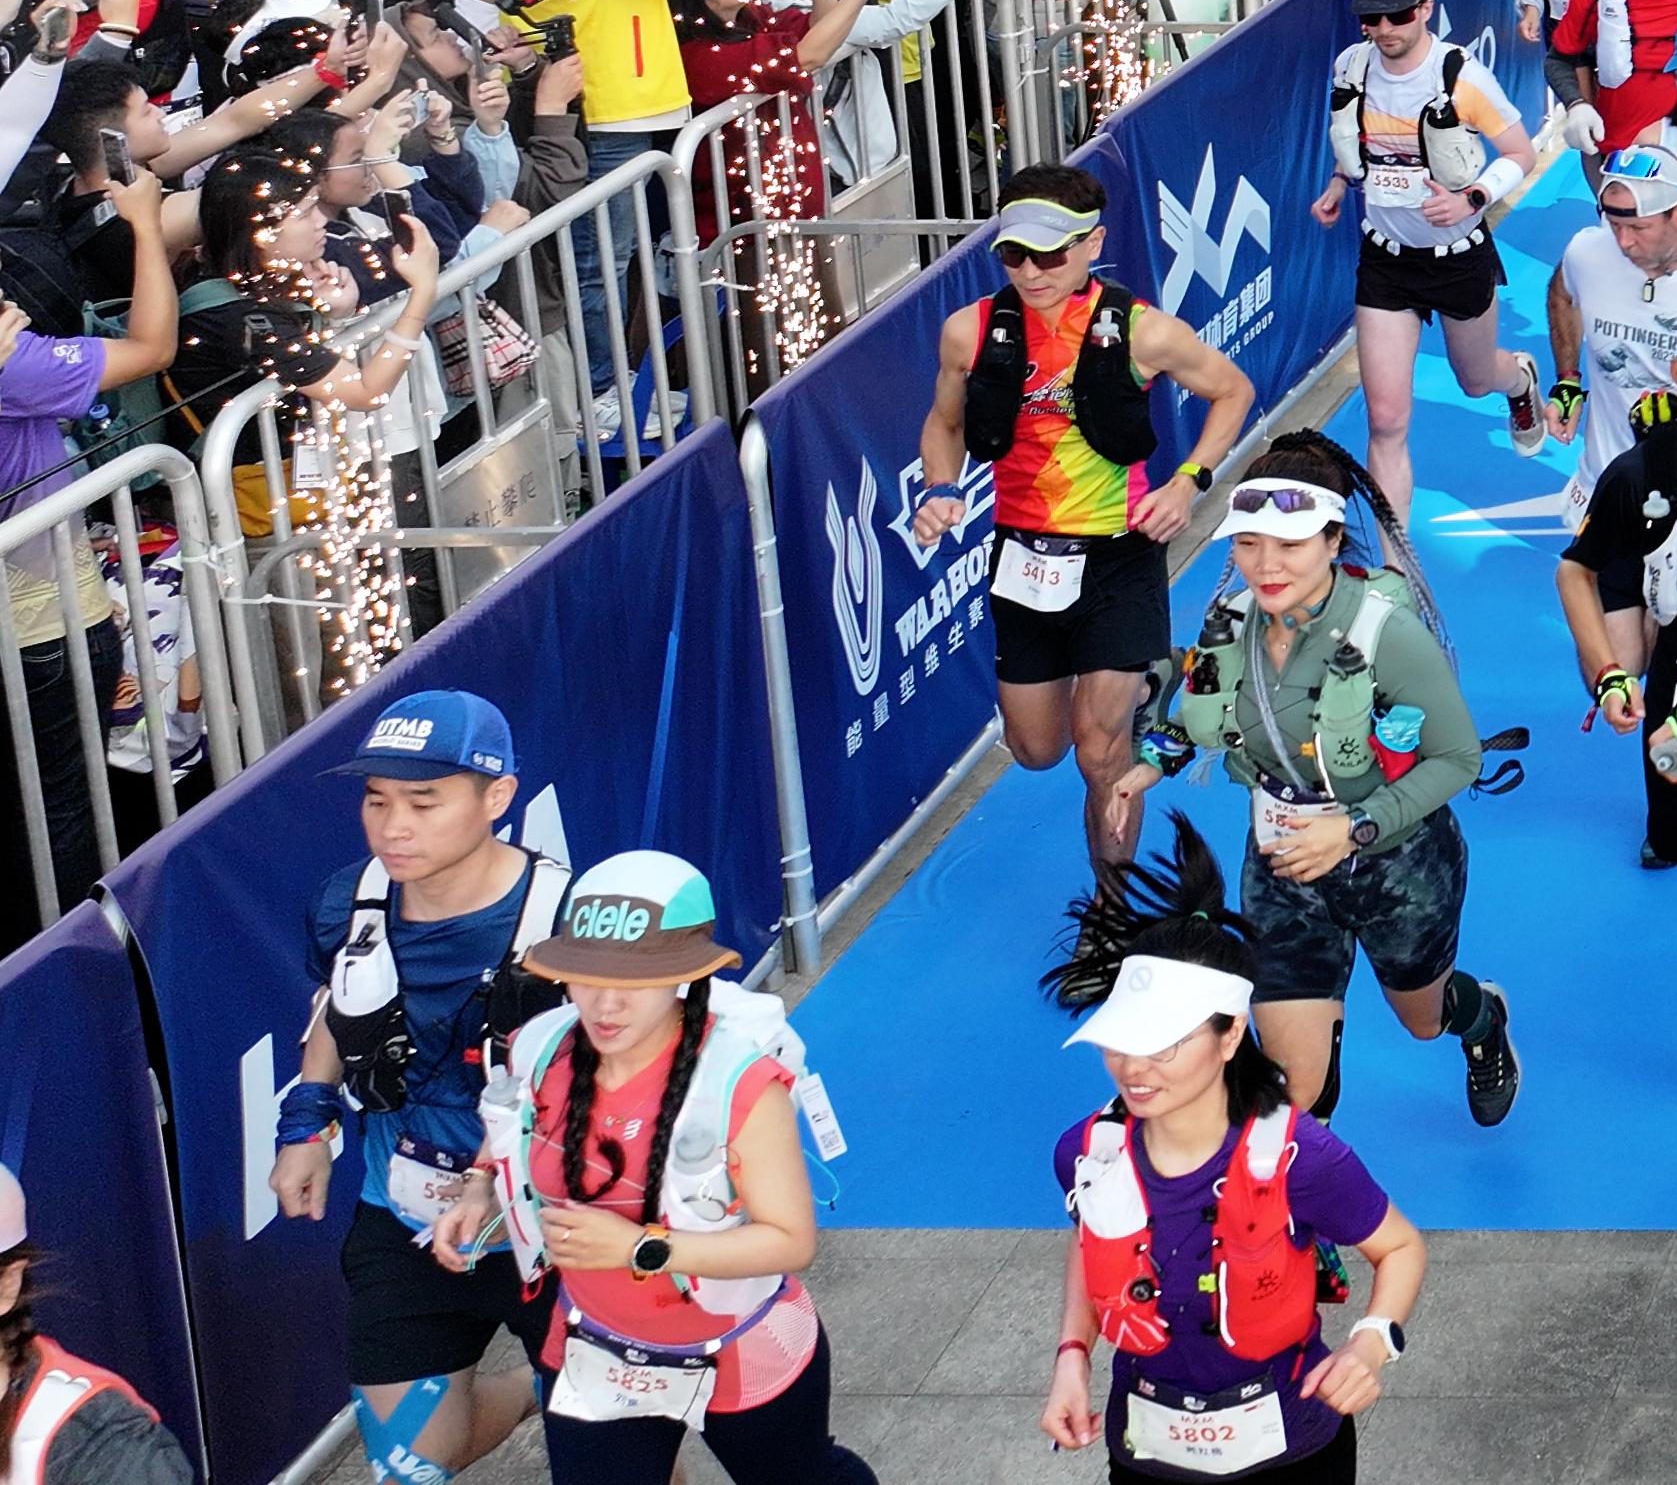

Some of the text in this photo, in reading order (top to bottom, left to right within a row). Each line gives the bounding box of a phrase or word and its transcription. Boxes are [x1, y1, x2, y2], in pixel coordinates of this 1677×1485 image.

[1373, 172, 1410, 191] 5533
[1244, 312, 1275, 349] GROUP
[1021, 563, 1061, 587] 5413
[893, 578, 951, 654] WAR
[375, 718, 434, 738] UTMB
[572, 898, 651, 943] ciele
[608, 1366, 668, 1396] 5825
[1180, 1414, 1215, 1425] MXM
[1167, 1423, 1238, 1443] 5802
